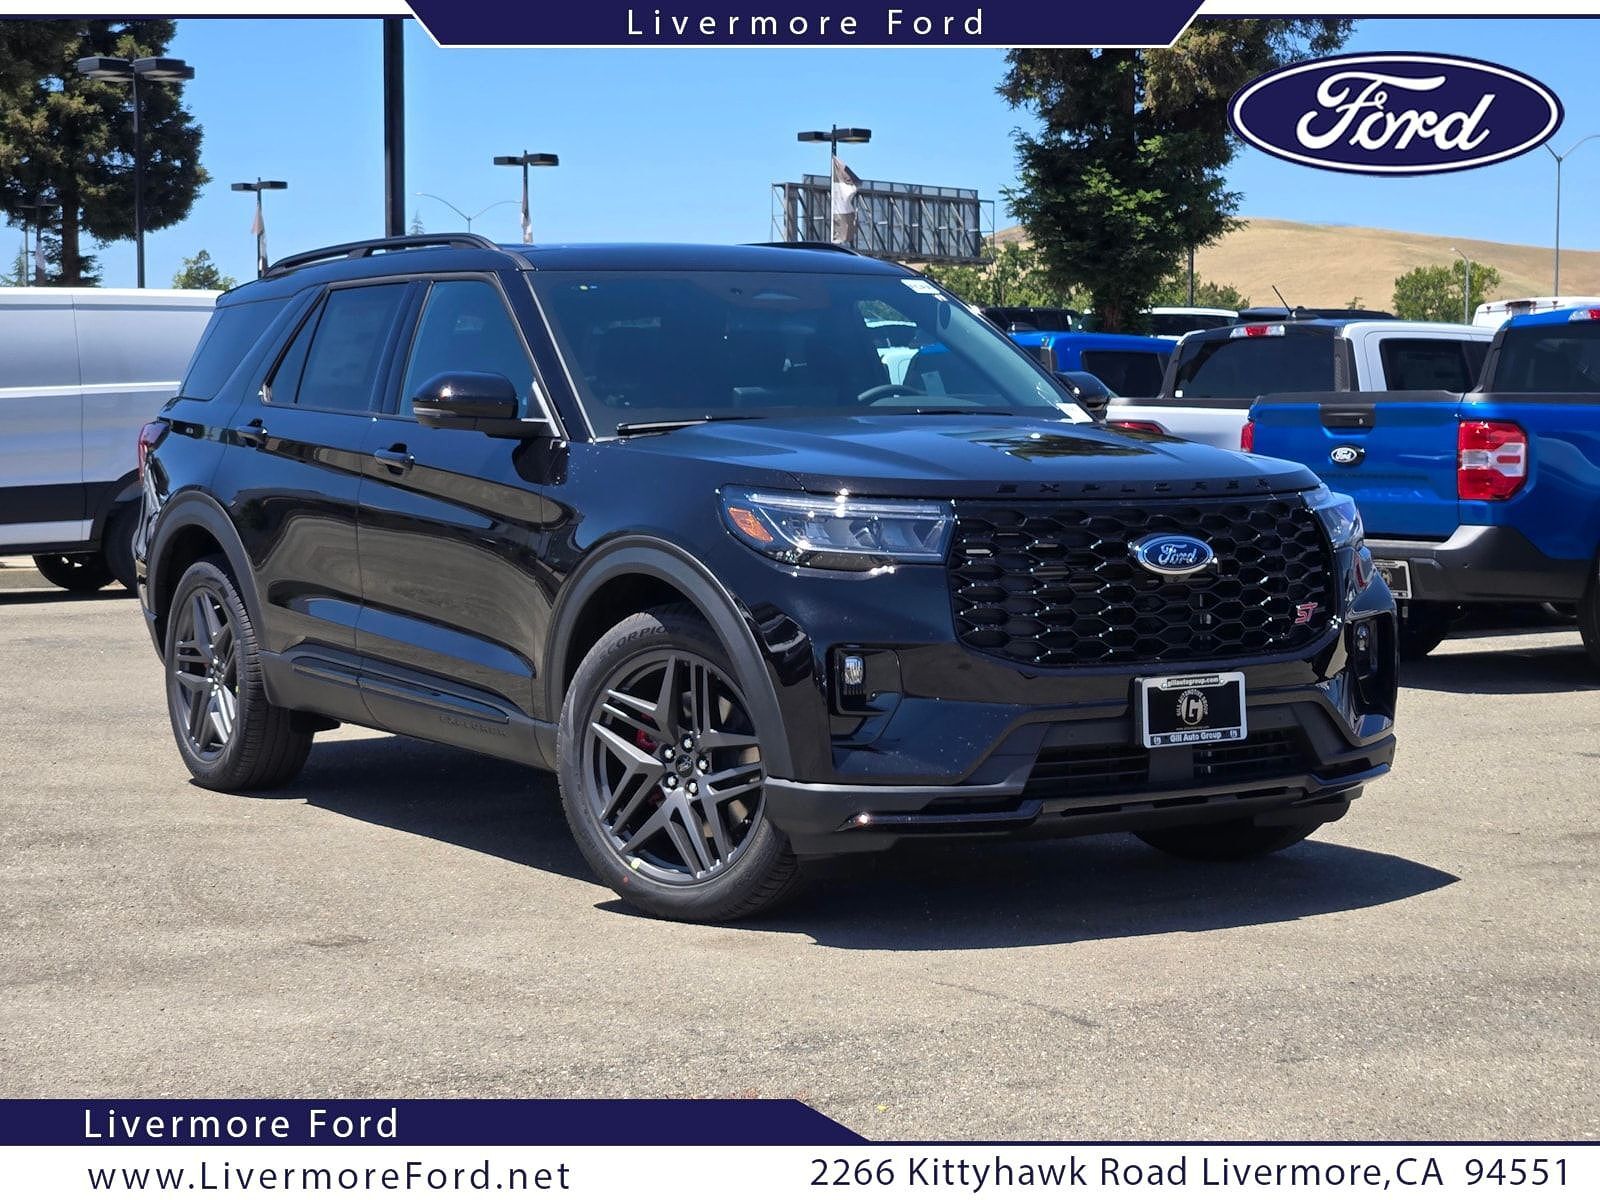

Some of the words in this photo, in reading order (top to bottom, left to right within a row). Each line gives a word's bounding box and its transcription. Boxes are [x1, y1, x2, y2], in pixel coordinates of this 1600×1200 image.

[1157, 543, 1198, 566] Ford
[1294, 602, 1319, 624] ST
[1167, 678, 1219, 688] gillautogroup.com
[1169, 735, 1182, 744] Gill
[1183, 733, 1200, 743] Auto
[1200, 731, 1221, 742] Group
